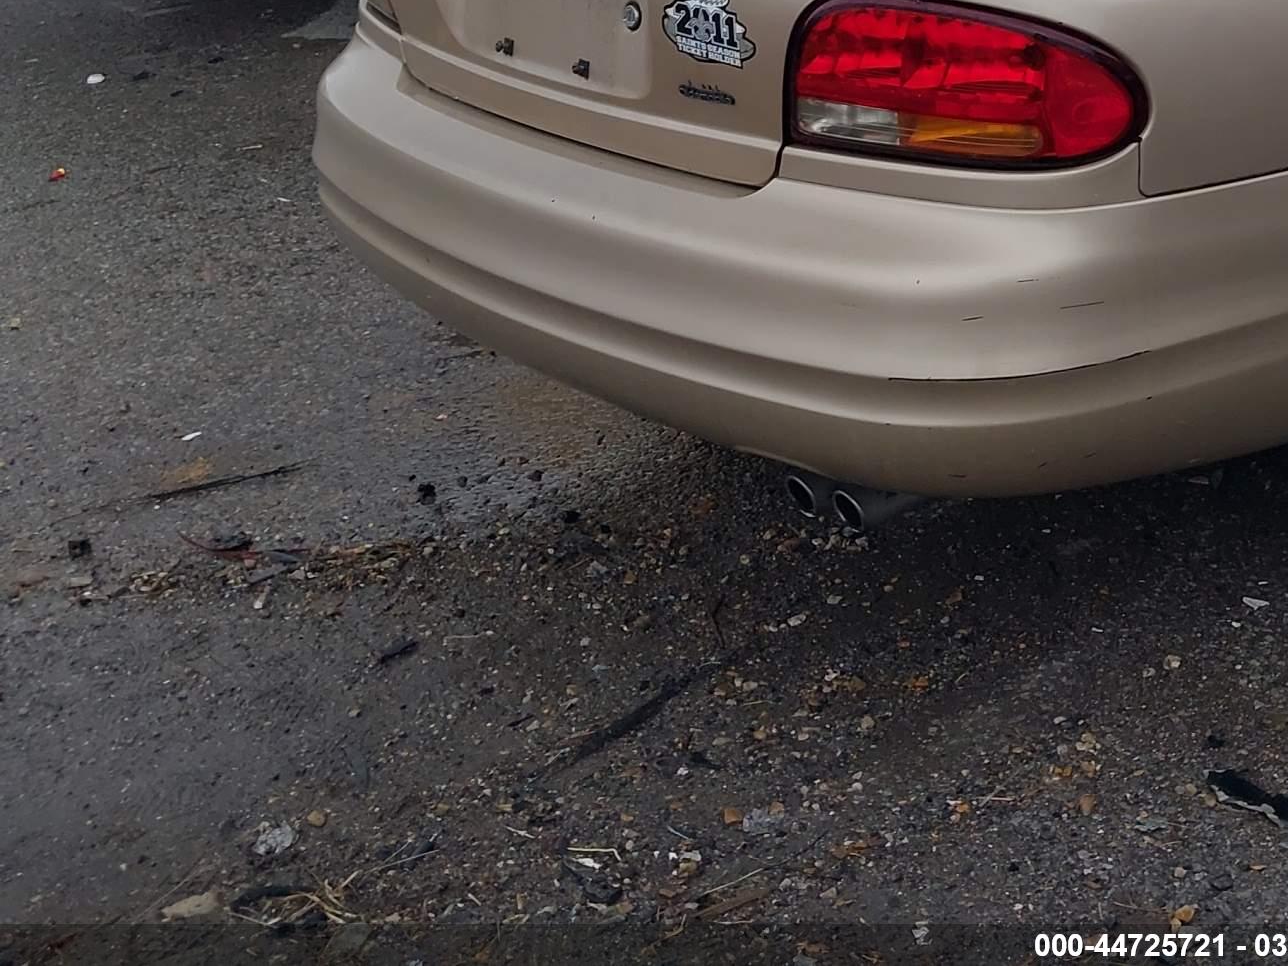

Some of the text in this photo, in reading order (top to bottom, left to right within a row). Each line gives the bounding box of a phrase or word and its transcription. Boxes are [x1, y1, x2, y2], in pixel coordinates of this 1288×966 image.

[676, 35, 741, 59] SAINTS SEASON
[677, 43, 708, 57] TICKET
